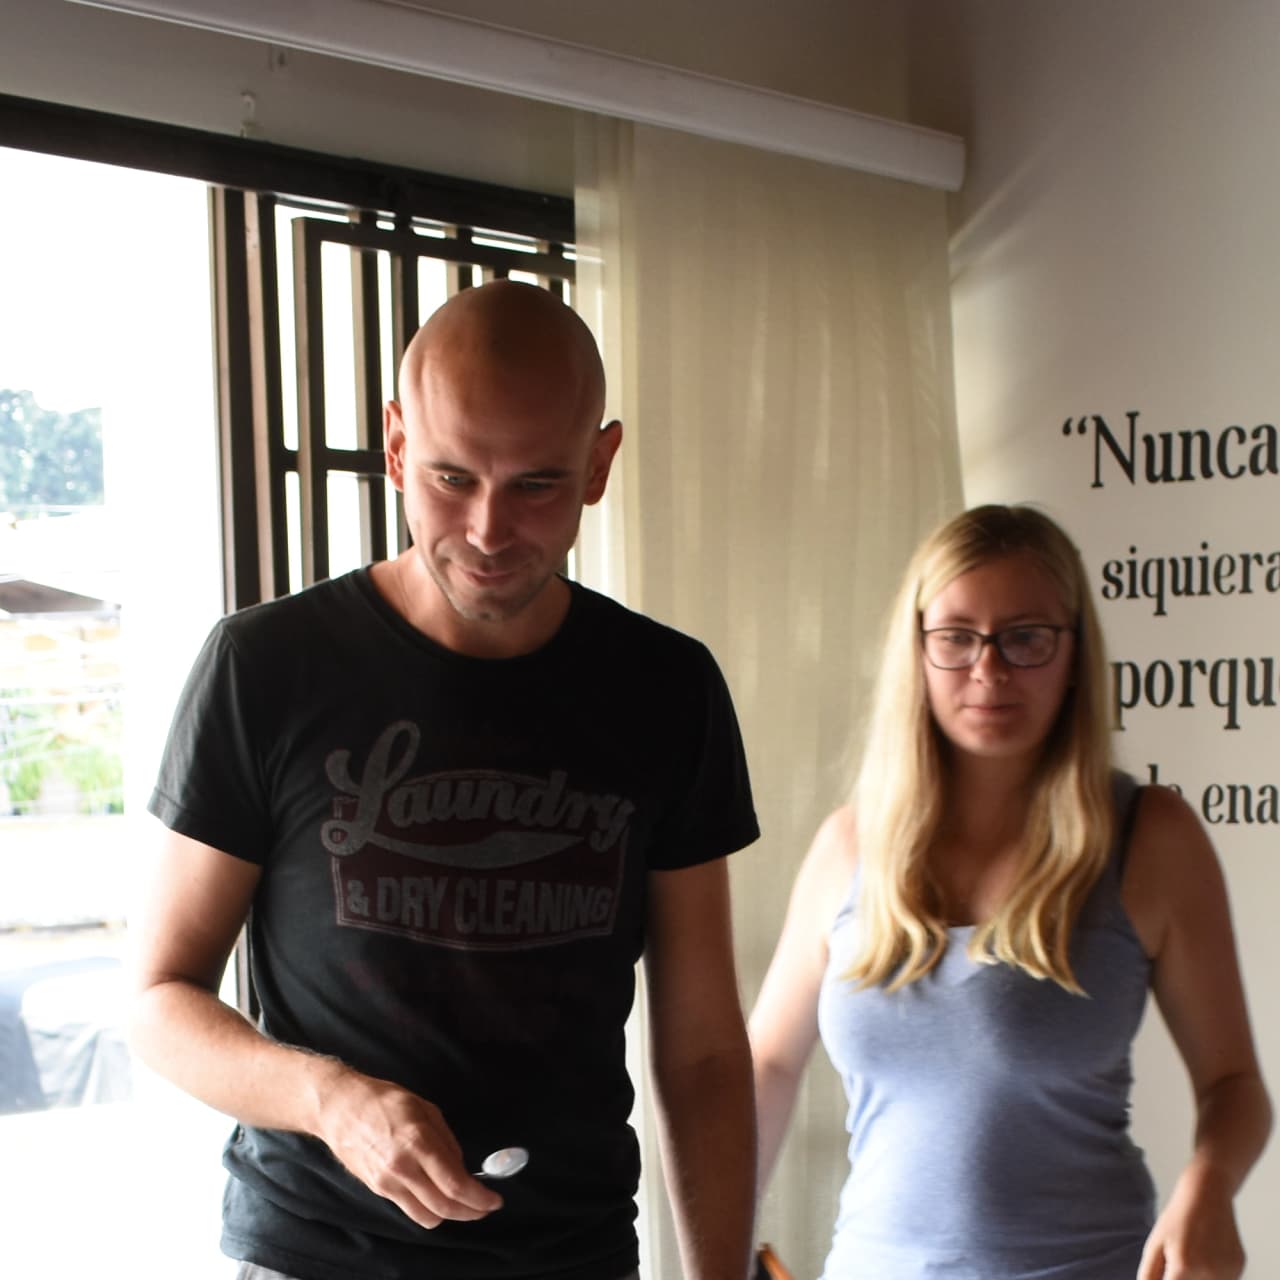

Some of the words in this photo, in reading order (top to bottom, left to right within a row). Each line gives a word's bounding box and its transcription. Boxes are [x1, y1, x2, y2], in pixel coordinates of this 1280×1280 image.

[320, 719, 635, 860] Laundry
[346, 879, 369, 917] &
[377, 877, 448, 929] DRY
[455, 877, 615, 935] CLEANING
